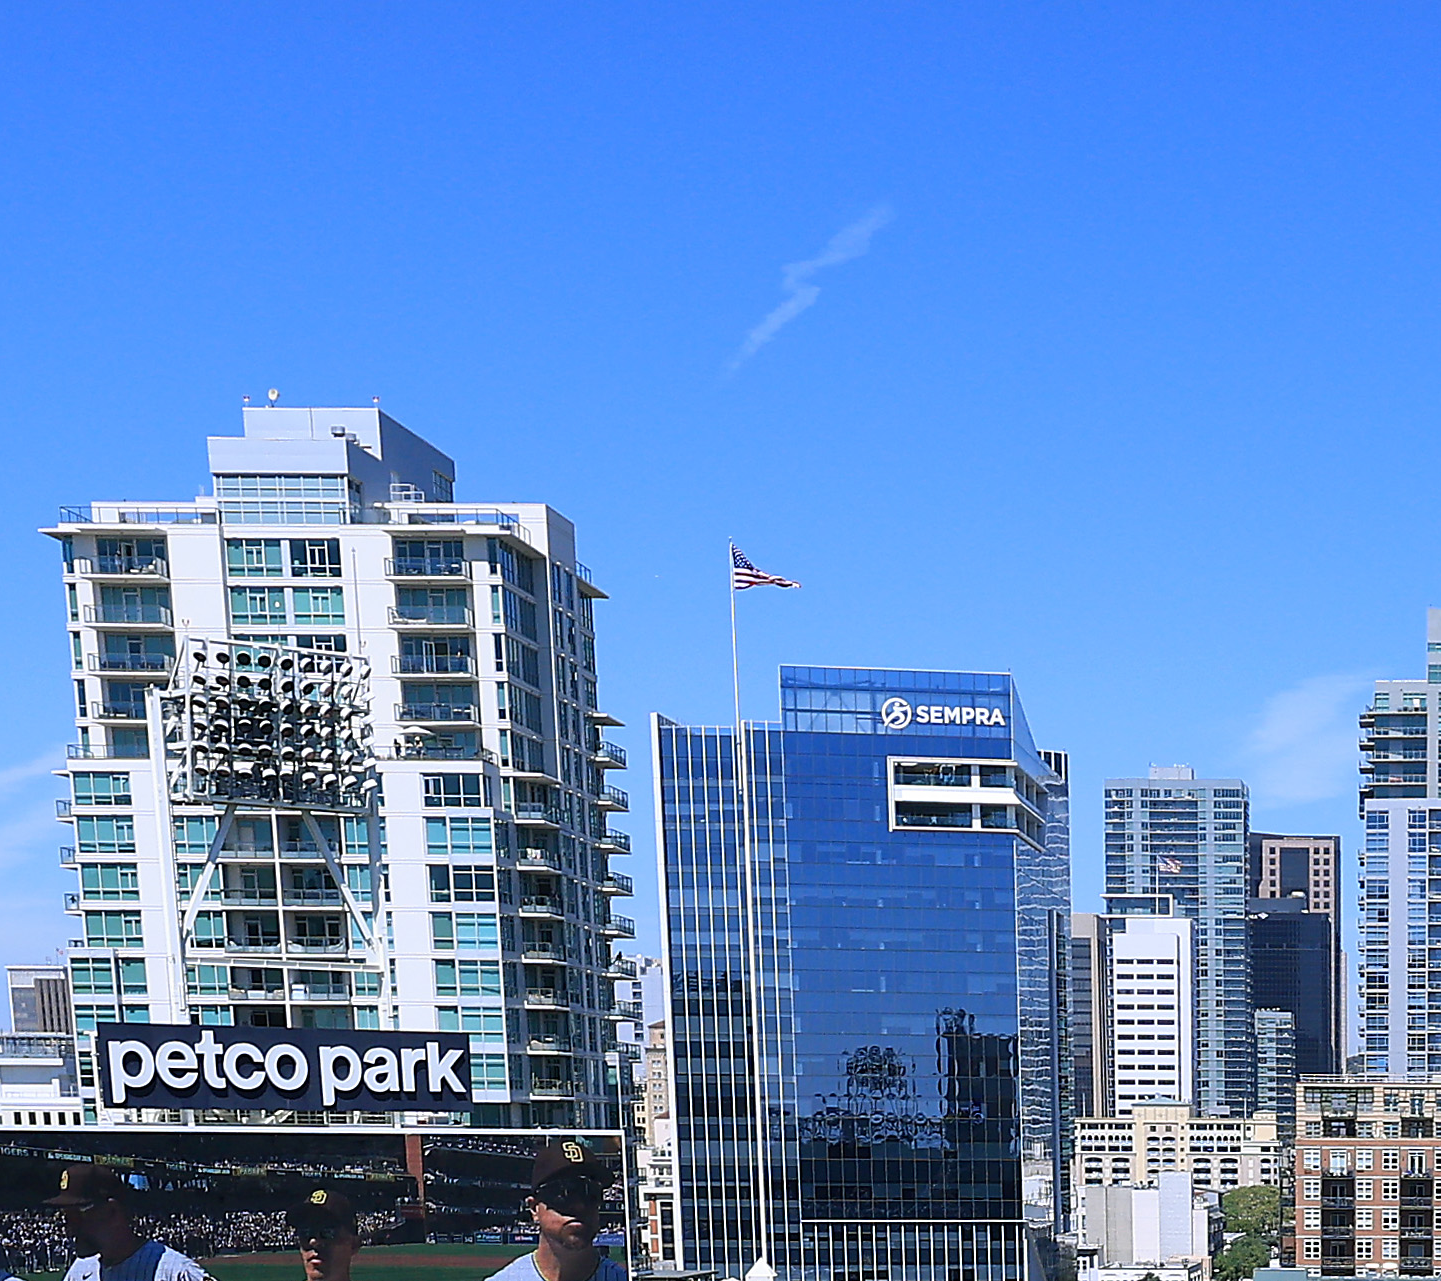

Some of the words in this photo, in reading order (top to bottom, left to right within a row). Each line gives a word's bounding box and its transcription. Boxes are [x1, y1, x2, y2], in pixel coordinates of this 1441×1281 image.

[916, 705, 1006, 726] SEMPRA
[108, 1030, 308, 1104] petco
[319, 1042, 466, 1106] park
